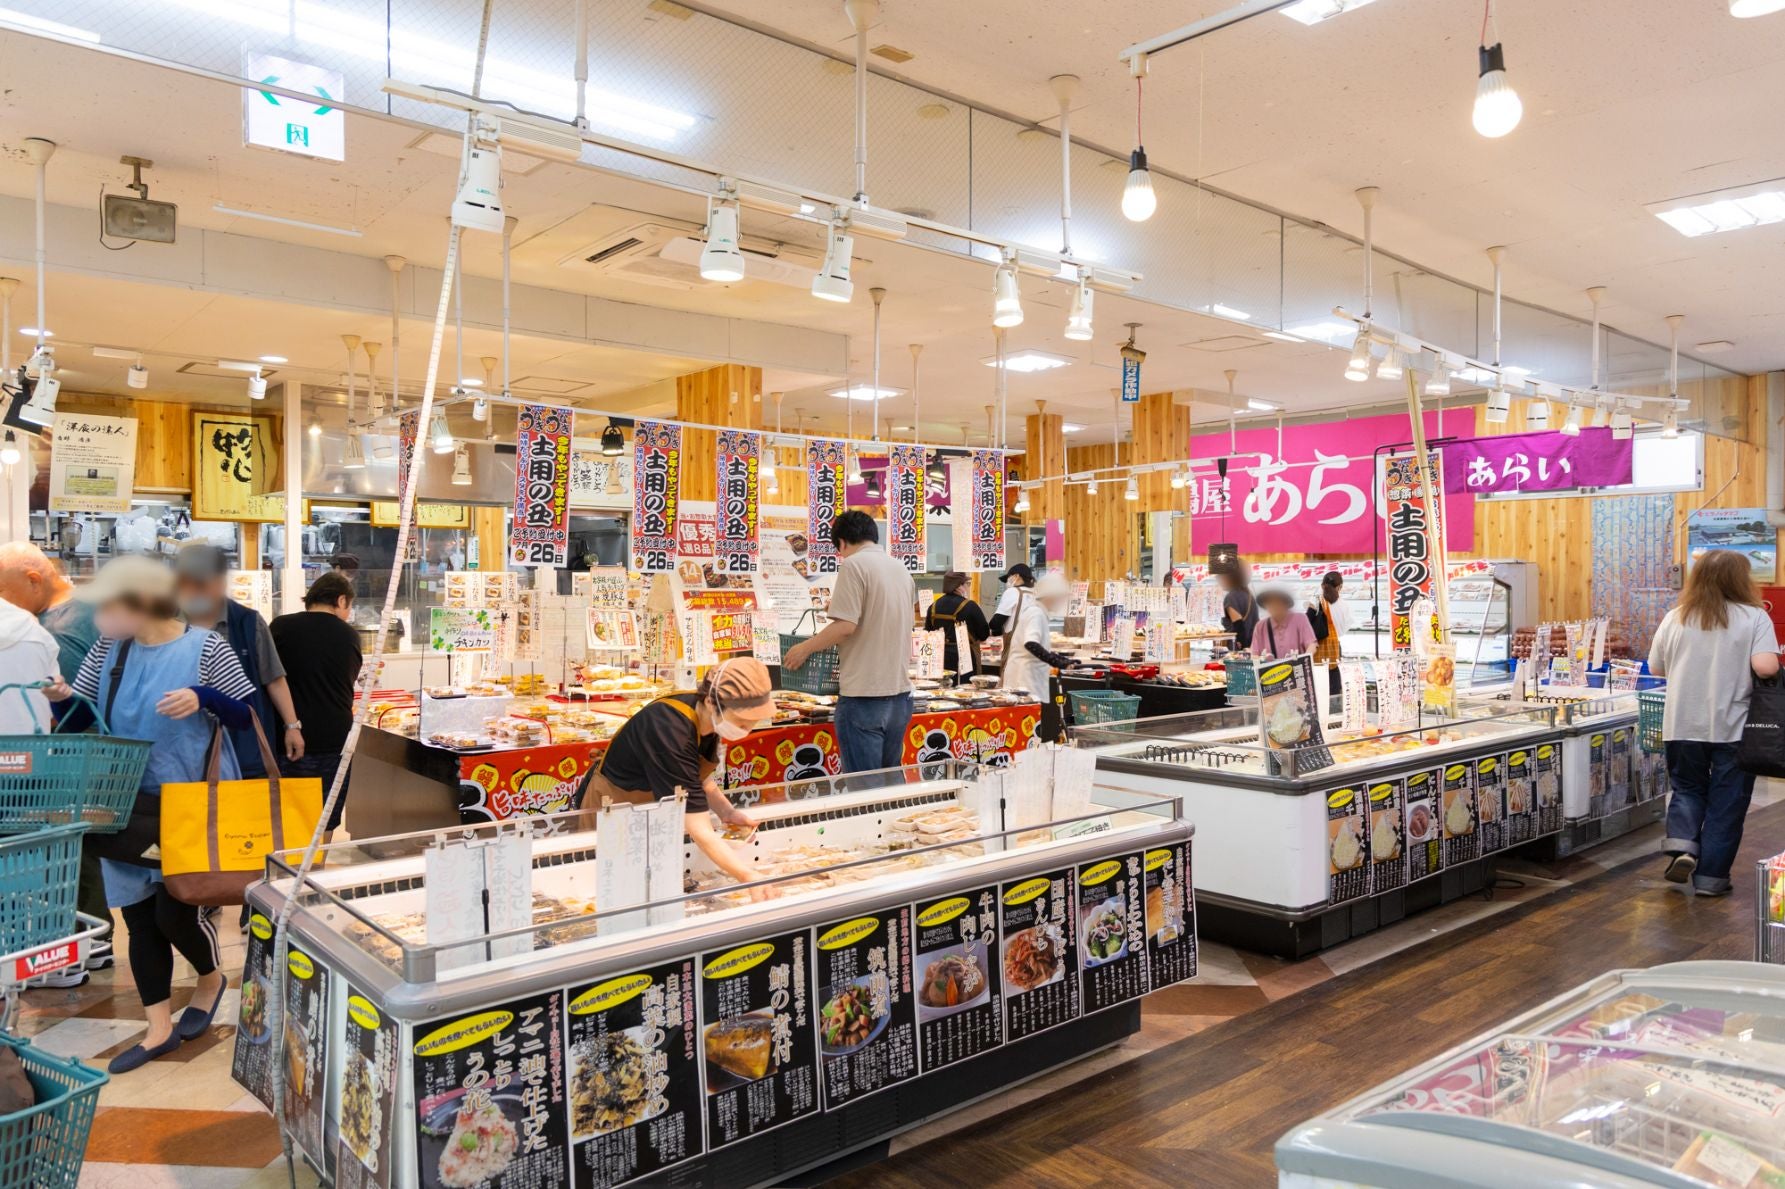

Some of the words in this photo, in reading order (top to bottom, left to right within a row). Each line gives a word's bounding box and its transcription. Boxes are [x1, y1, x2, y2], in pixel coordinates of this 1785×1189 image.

[527, 435, 555, 527] 土用の丑
[643, 449, 667, 536] 土用の丑
[726, 457, 747, 541] 土用の丑
[899, 469, 916, 543] 土用の丑
[980, 472, 996, 541] 土用の丑
[1467, 453, 1571, 487] あらい
[454, 638, 490, 648] チキンカツ
[959, 914, 980, 993] 肉じゃが
[978, 891, 996, 946] 牛肉の
[26, 945, 70, 973] VALUE
[867, 946, 889, 1020] 筑前煮
[665, 973, 683, 1029] 自家製
[768, 963, 794, 1067] 鯖の煮付
[462, 1052, 492, 1114] うの花
[493, 1032, 516, 1091] しっとり
[518, 1006, 550, 1154] アマニ油で仕上げた
[641, 983, 670, 1117] 高菜の油炒め
